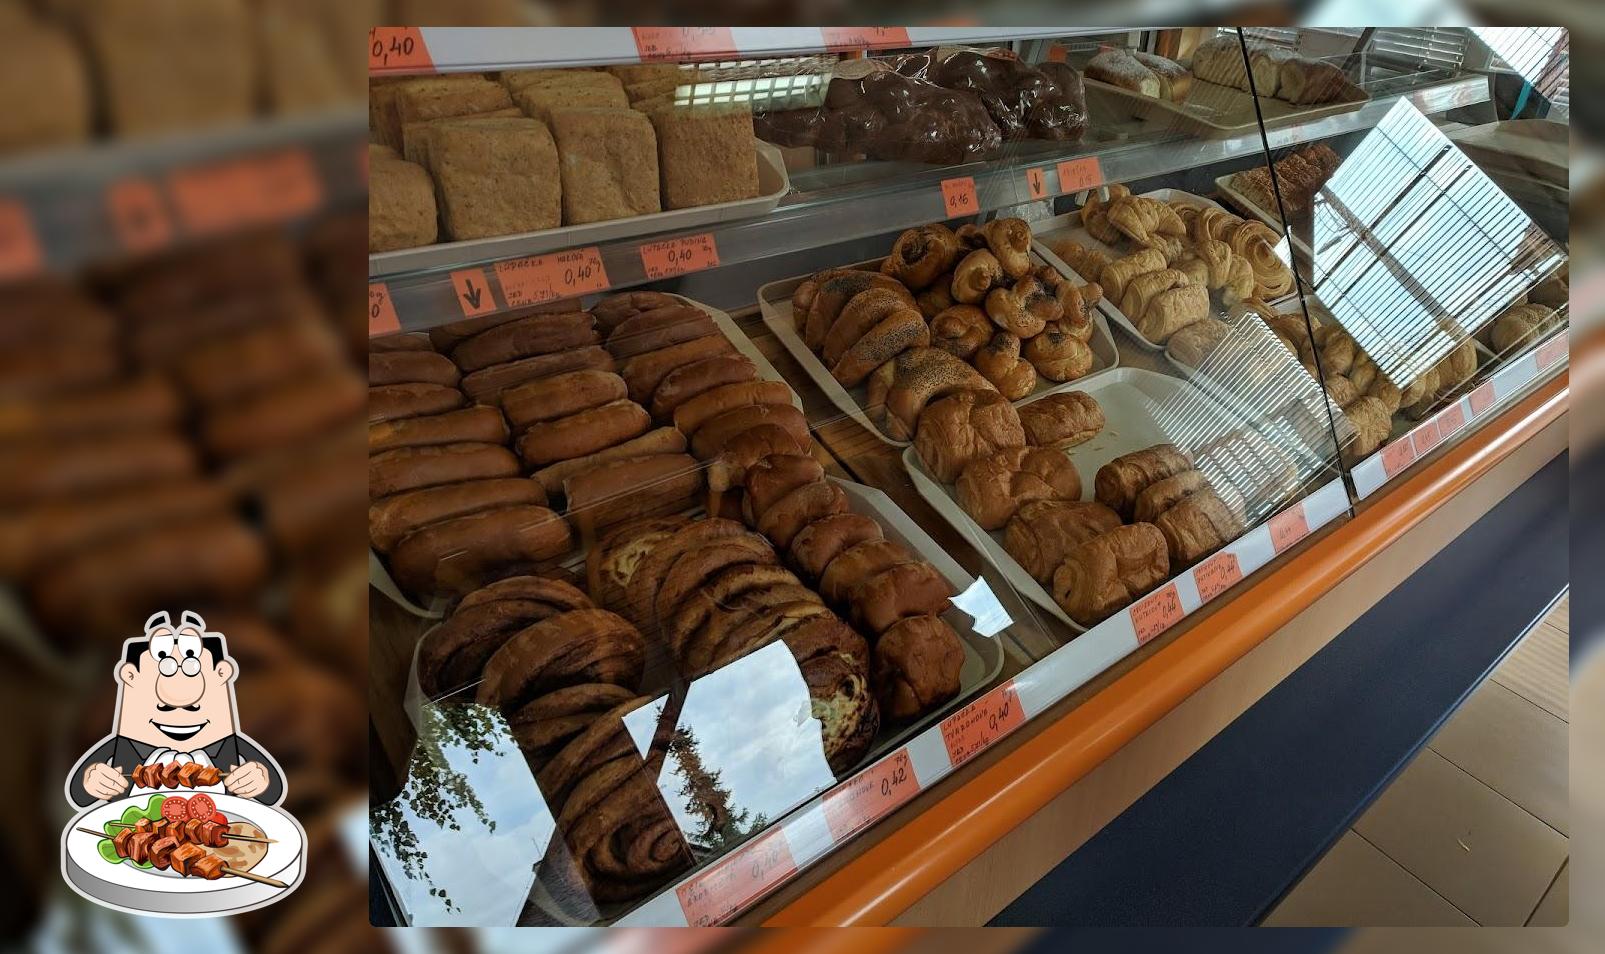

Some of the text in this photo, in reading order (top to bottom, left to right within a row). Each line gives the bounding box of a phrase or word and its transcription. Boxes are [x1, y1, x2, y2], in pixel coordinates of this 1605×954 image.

[372, 36, 414, 66] 0,40
[668, 248, 692, 267] 0,40
[564, 265, 592, 288] 0,40
[989, 702, 1009, 731] 0,40
[881, 768, 907, 796] 0,42
